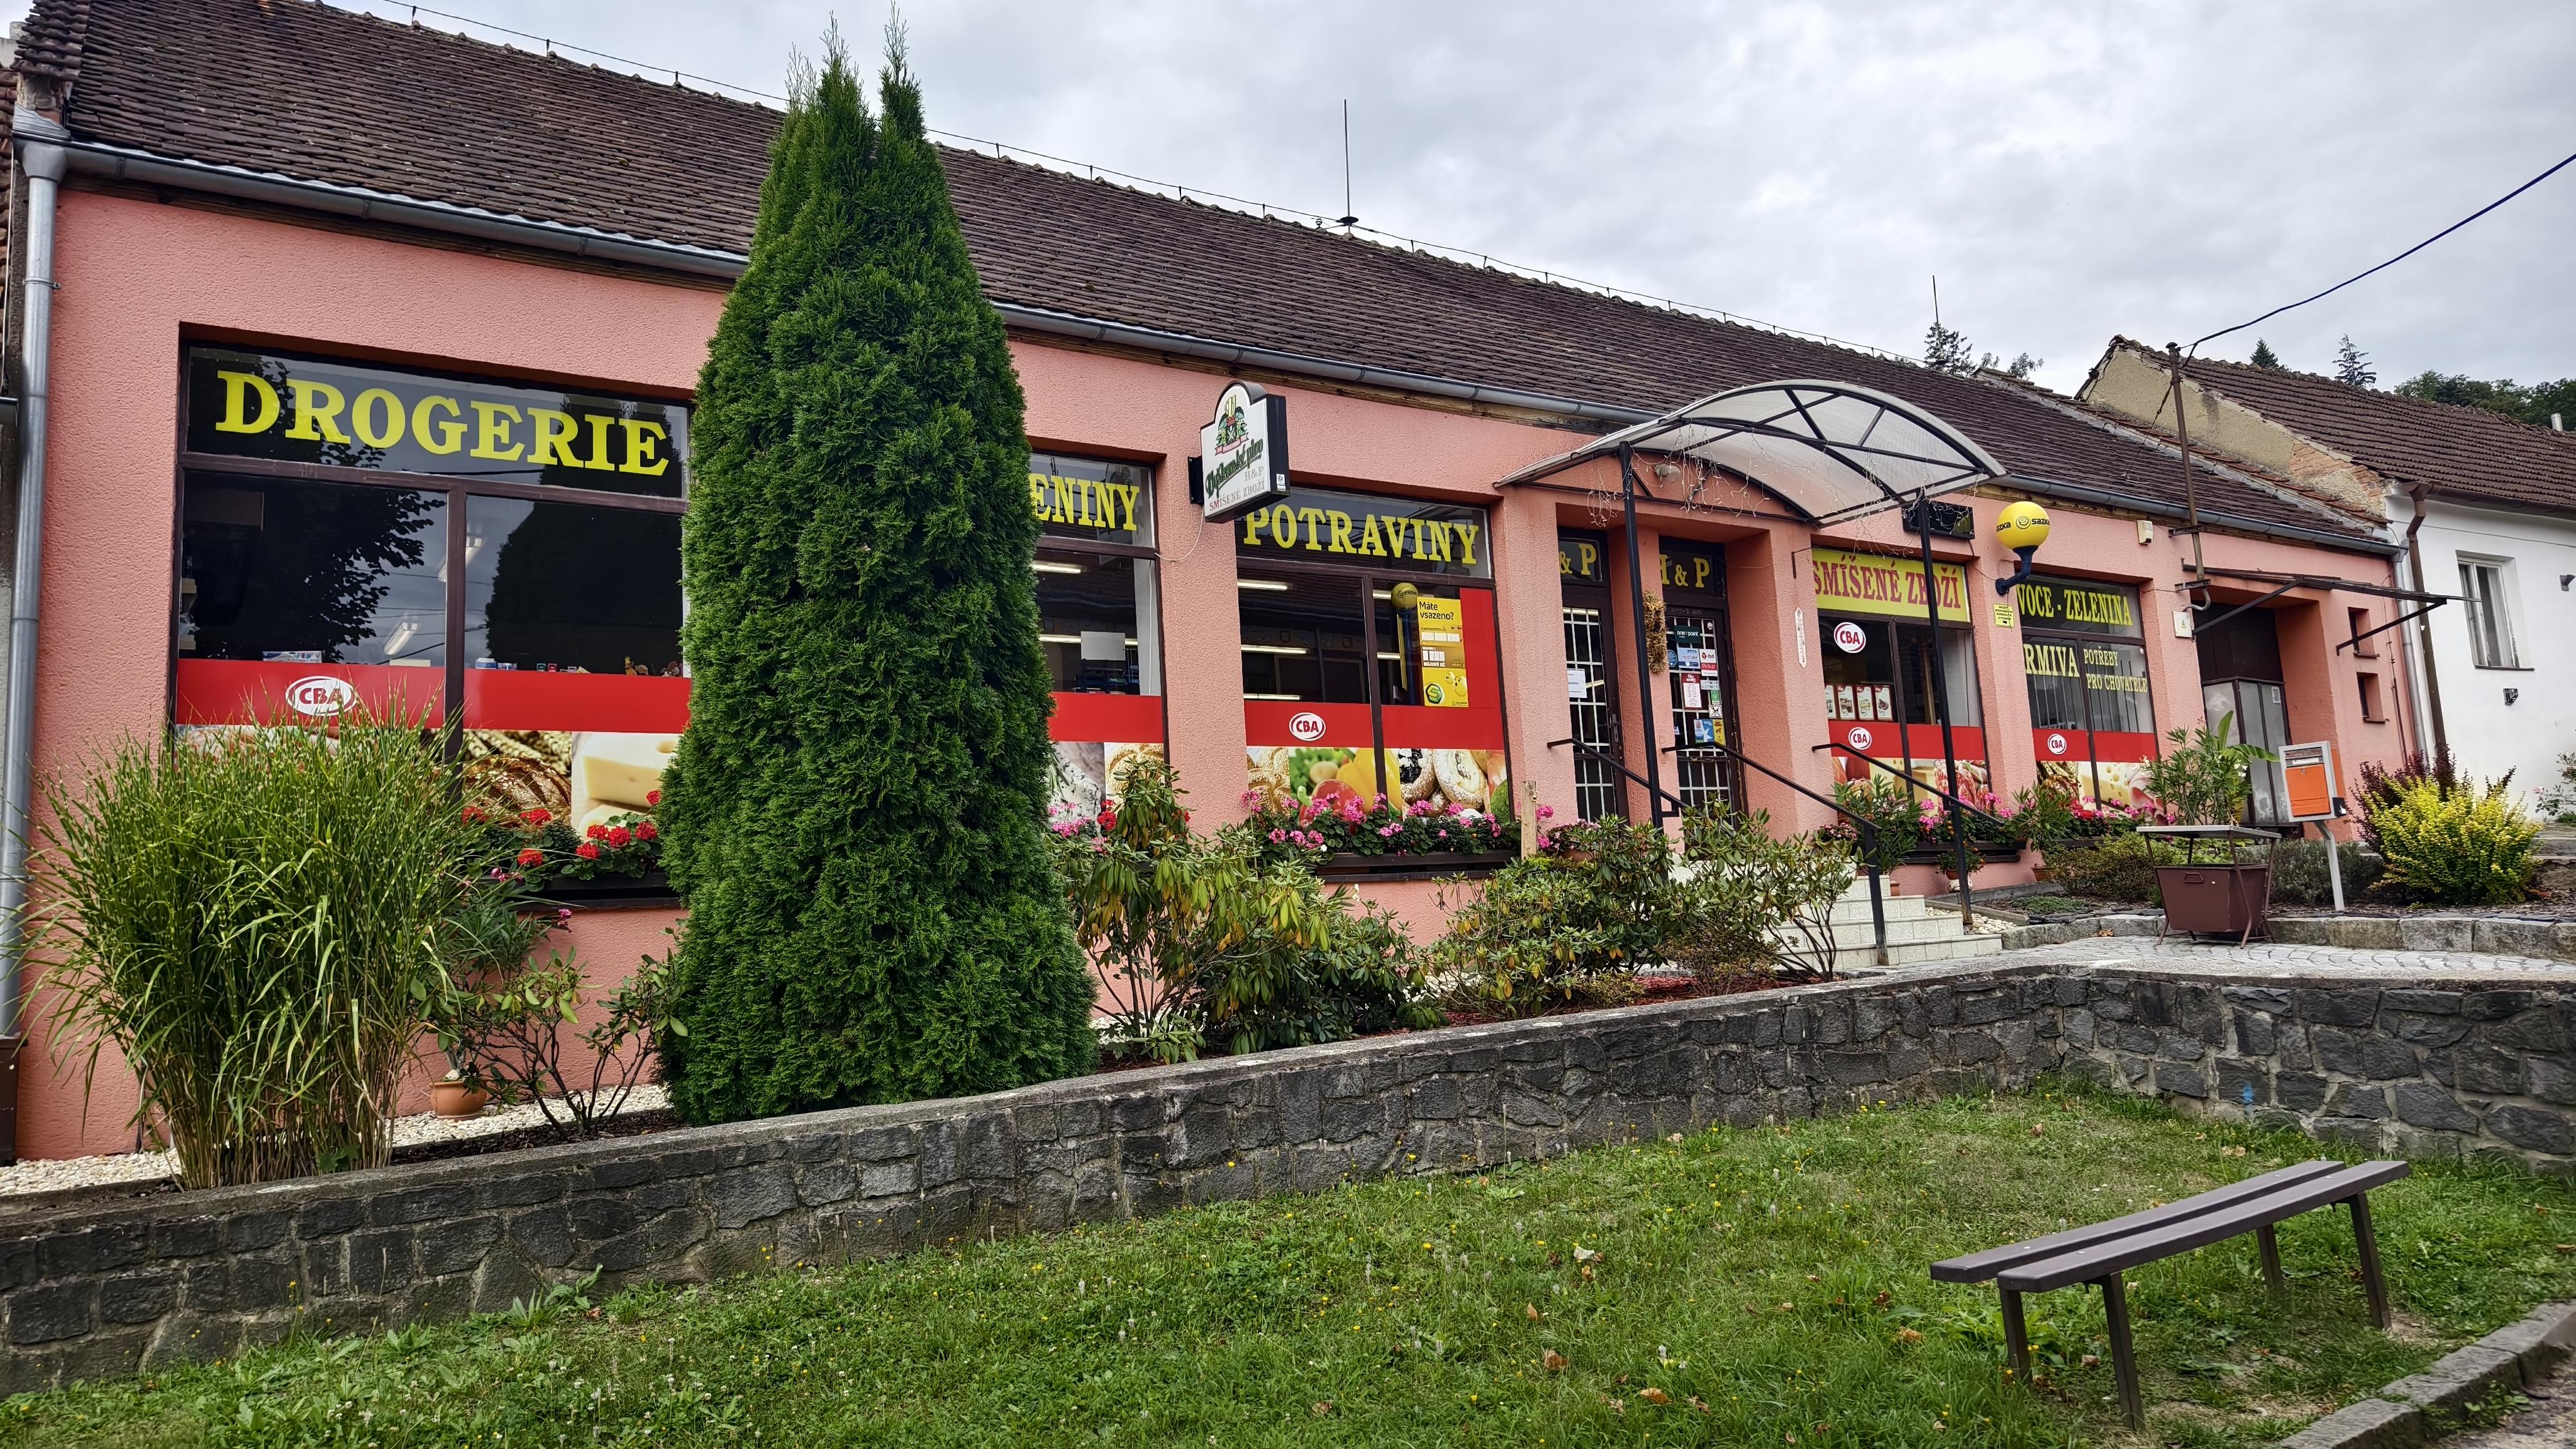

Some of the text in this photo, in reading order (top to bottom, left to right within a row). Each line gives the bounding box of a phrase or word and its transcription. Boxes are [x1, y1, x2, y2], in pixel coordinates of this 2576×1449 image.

[215, 370, 669, 477] DROGERIE
[1244, 466, 1264, 481] H&P
[1028, 473, 1140, 531] ENINY
[1209, 487, 1241, 511] SMÍŠENÉ
[1243, 477, 1265, 497] ZBOŽÍ
[1244, 504, 1479, 564] POTRAVINY
[1578, 543, 1596, 576] P
[1674, 564, 1689, 587] &
[1693, 558, 1710, 588] P
[1419, 601, 1438, 611] Máte
[2016, 583, 2054, 618] VOCE
[2064, 589, 2133, 626] ZELENINA
[1421, 612, 1454, 620] vsazeno?
[1840, 630, 1860, 645] CBA
[2023, 644, 2080, 677] RMIVA
[2083, 646, 2118, 666] POTŘEBY
[2087, 674, 2148, 693] PRO CHOVATELE
[298, 687, 341, 705] CBA
[1296, 720, 1320, 733] CBA
[1853, 734, 1868, 743] CBA
[2051, 740, 2063, 749] CBA
